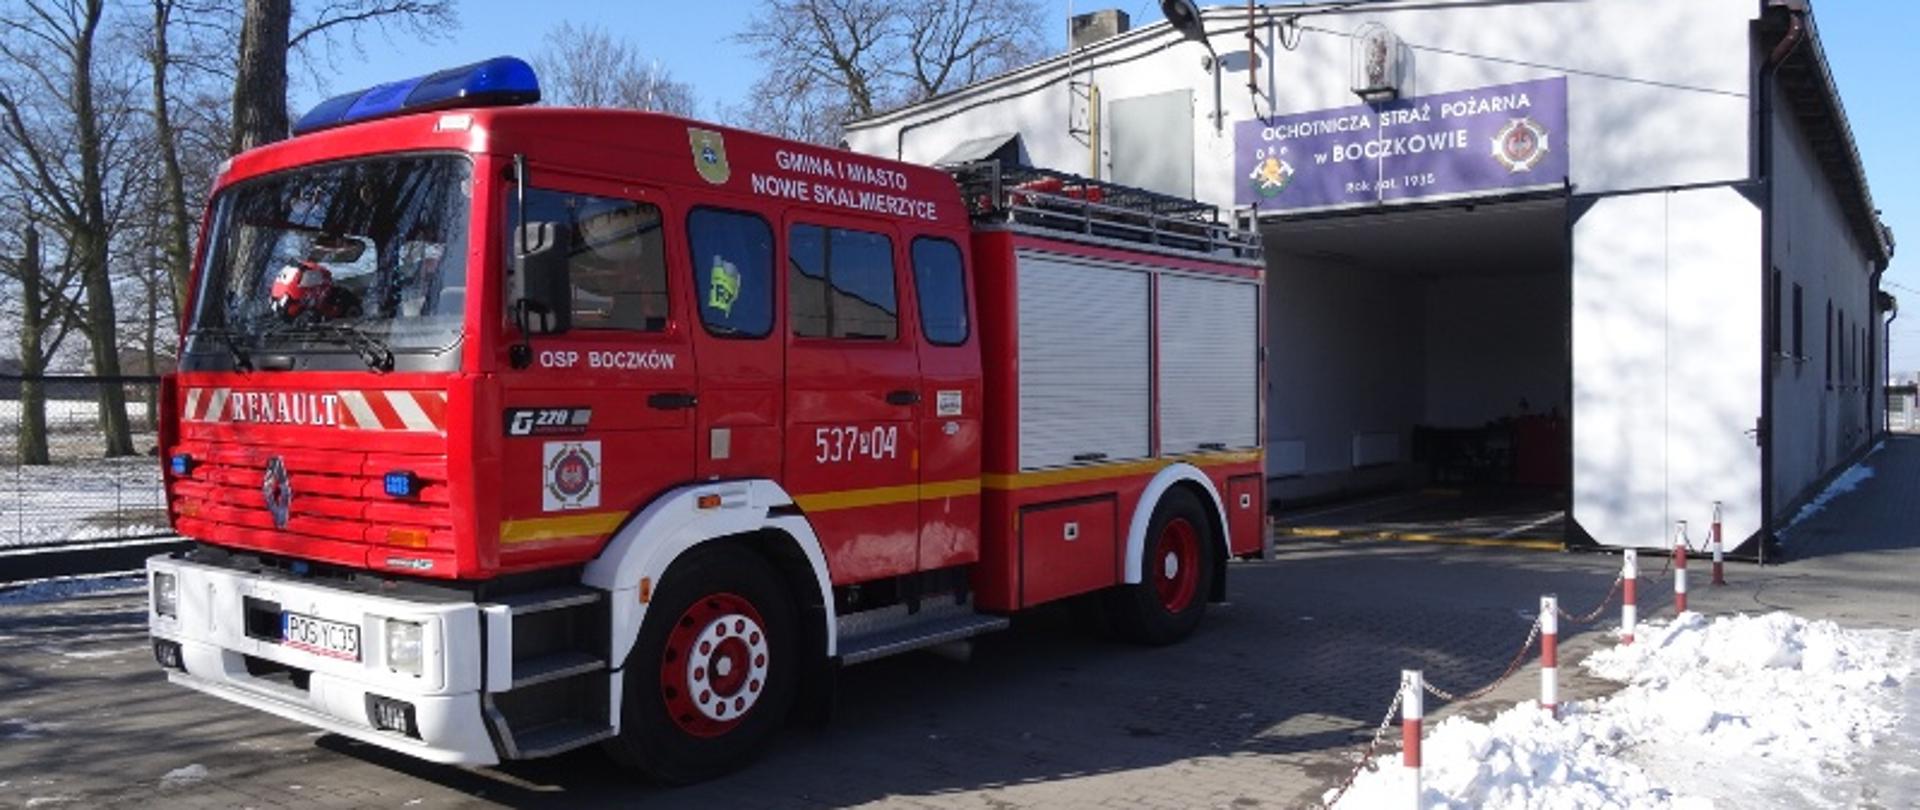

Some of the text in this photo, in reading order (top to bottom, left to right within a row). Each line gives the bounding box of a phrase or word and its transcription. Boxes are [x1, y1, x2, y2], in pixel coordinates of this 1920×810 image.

[1262, 93, 1531, 142] OCHOTNICZA STRAŻ POŻARNA
[1332, 129, 1469, 163] BOCZKOWIE
[776, 151, 834, 178] GMINA
[847, 164, 907, 191] MIASTO
[752, 173, 937, 220] NOWE SKALMIERZYCE
[540, 349, 676, 370] OSP BOCZKÓW
[231, 391, 338, 426] RENAULT
